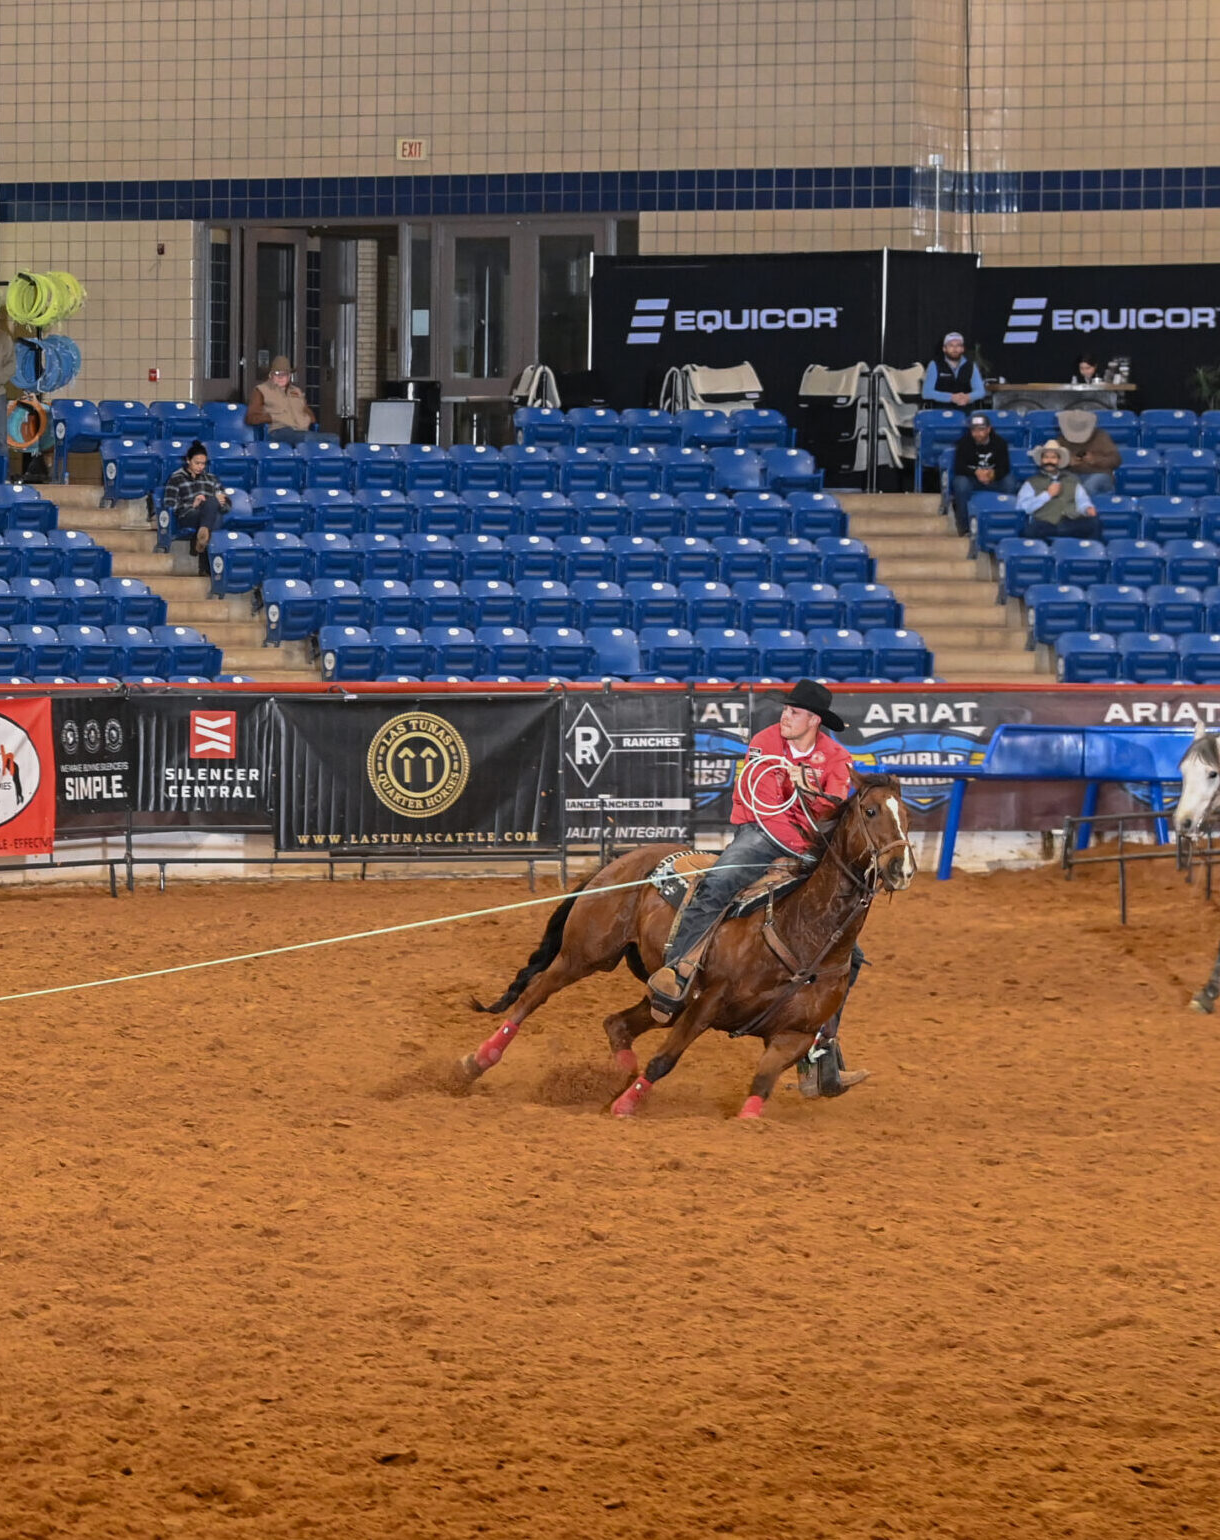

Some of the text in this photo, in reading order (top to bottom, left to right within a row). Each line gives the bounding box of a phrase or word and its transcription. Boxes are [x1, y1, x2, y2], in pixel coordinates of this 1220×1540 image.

[402, 141, 422, 158] EXIT
[675, 307, 837, 333] EQUICOR
[1052, 307, 1216, 333] EQUICOR
[864, 702, 978, 723] ARIAT
[1104, 702, 1220, 723] ARIAT
[382, 720, 453, 747] LAS TUNAS
[623, 737, 680, 748] RANCHES
[165, 768, 259, 781] SILENCER
[65, 775, 128, 800] SIMPLE.
[168, 785, 256, 798] CENTRAL
[378, 771, 460, 809] QUARTER HORSES
[297, 831, 540, 845] WWW.LASTUNASCATTLE.COM
[615, 826, 688, 839] INTEGRITY.
